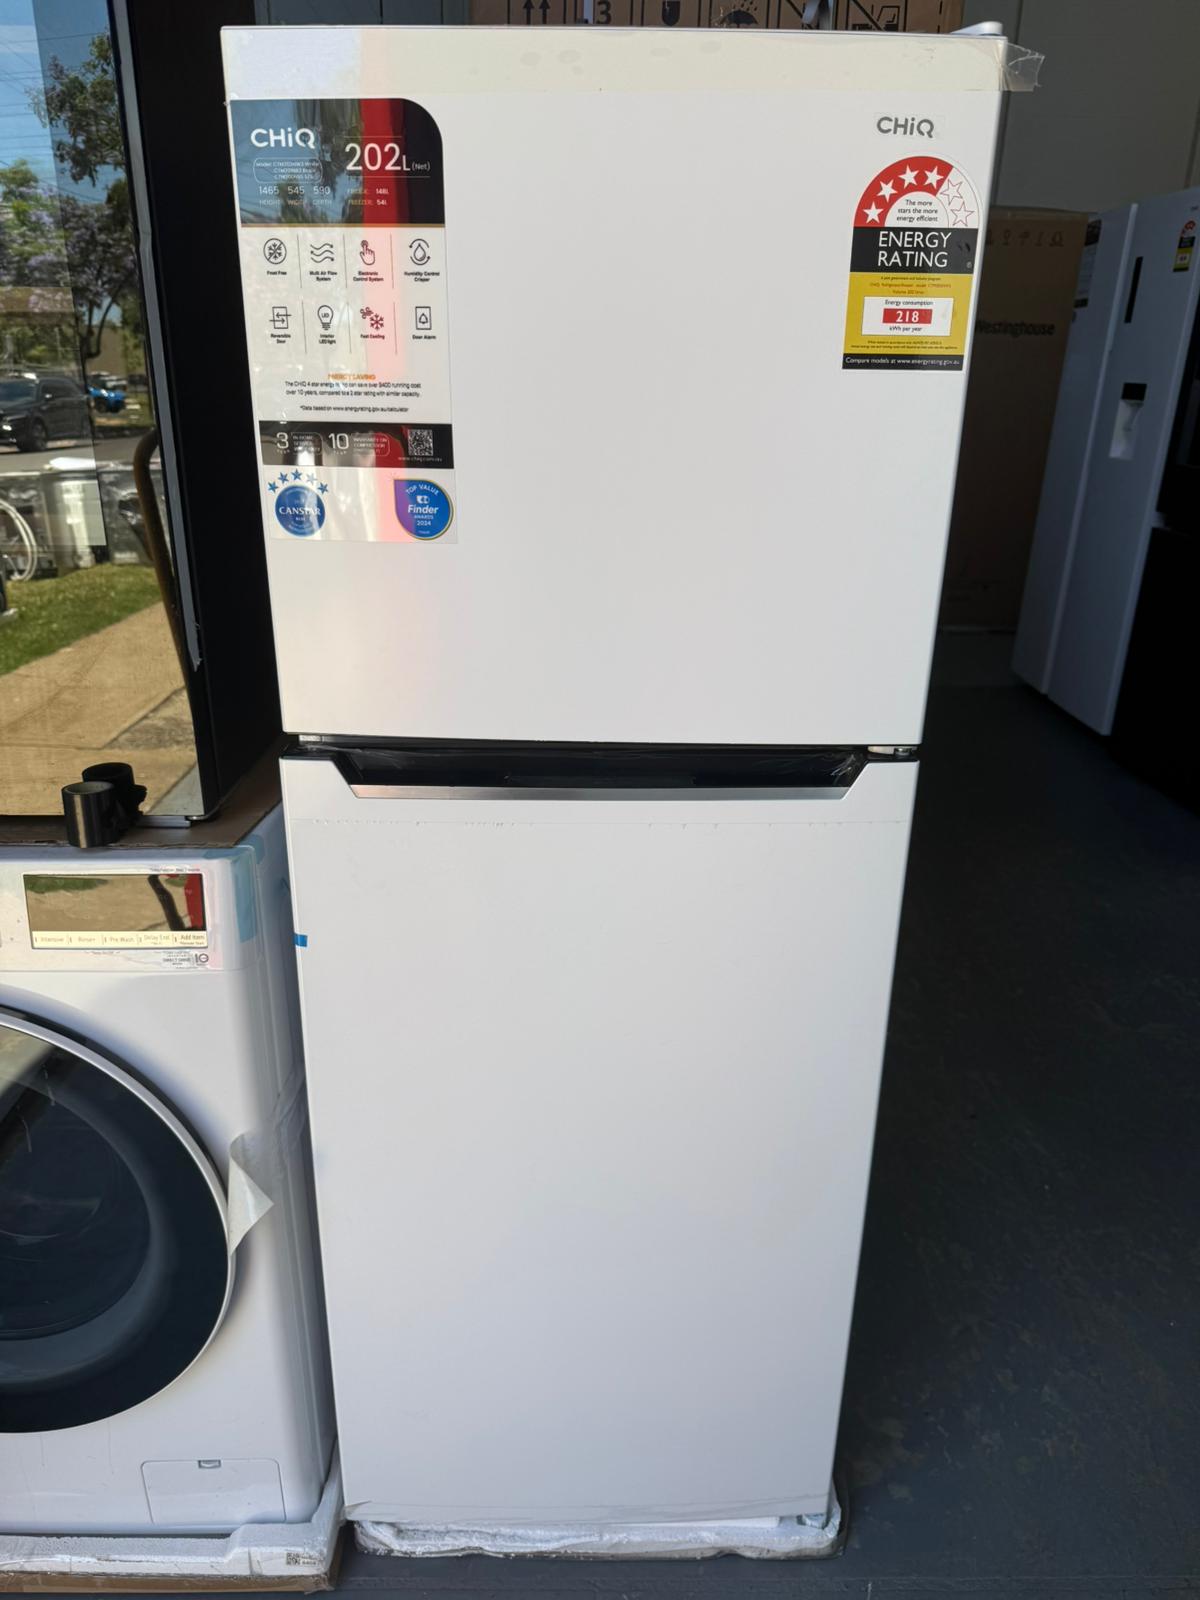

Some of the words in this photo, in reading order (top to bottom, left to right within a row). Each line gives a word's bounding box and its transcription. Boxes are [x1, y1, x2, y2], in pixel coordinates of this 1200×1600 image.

[877, 116, 934, 138] CHiQ
[250, 128, 316, 149] CHiQ
[259, 186, 280, 195] 1465
[287, 186, 305, 195] 545
[313, 186, 331, 195] 590
[879, 231, 952, 248] ENERGY
[877, 251, 949, 267] RATING
[895, 311, 919, 323] 218
[845, 357, 870, 365] Compare
[276, 432, 289, 449] 3
[328, 433, 349, 449] 10
[406, 485, 417, 495] TOP
[419, 483, 439, 496] VALUE
[279, 506, 321, 516] CANSTAR
[407, 504, 439, 514] Finder
